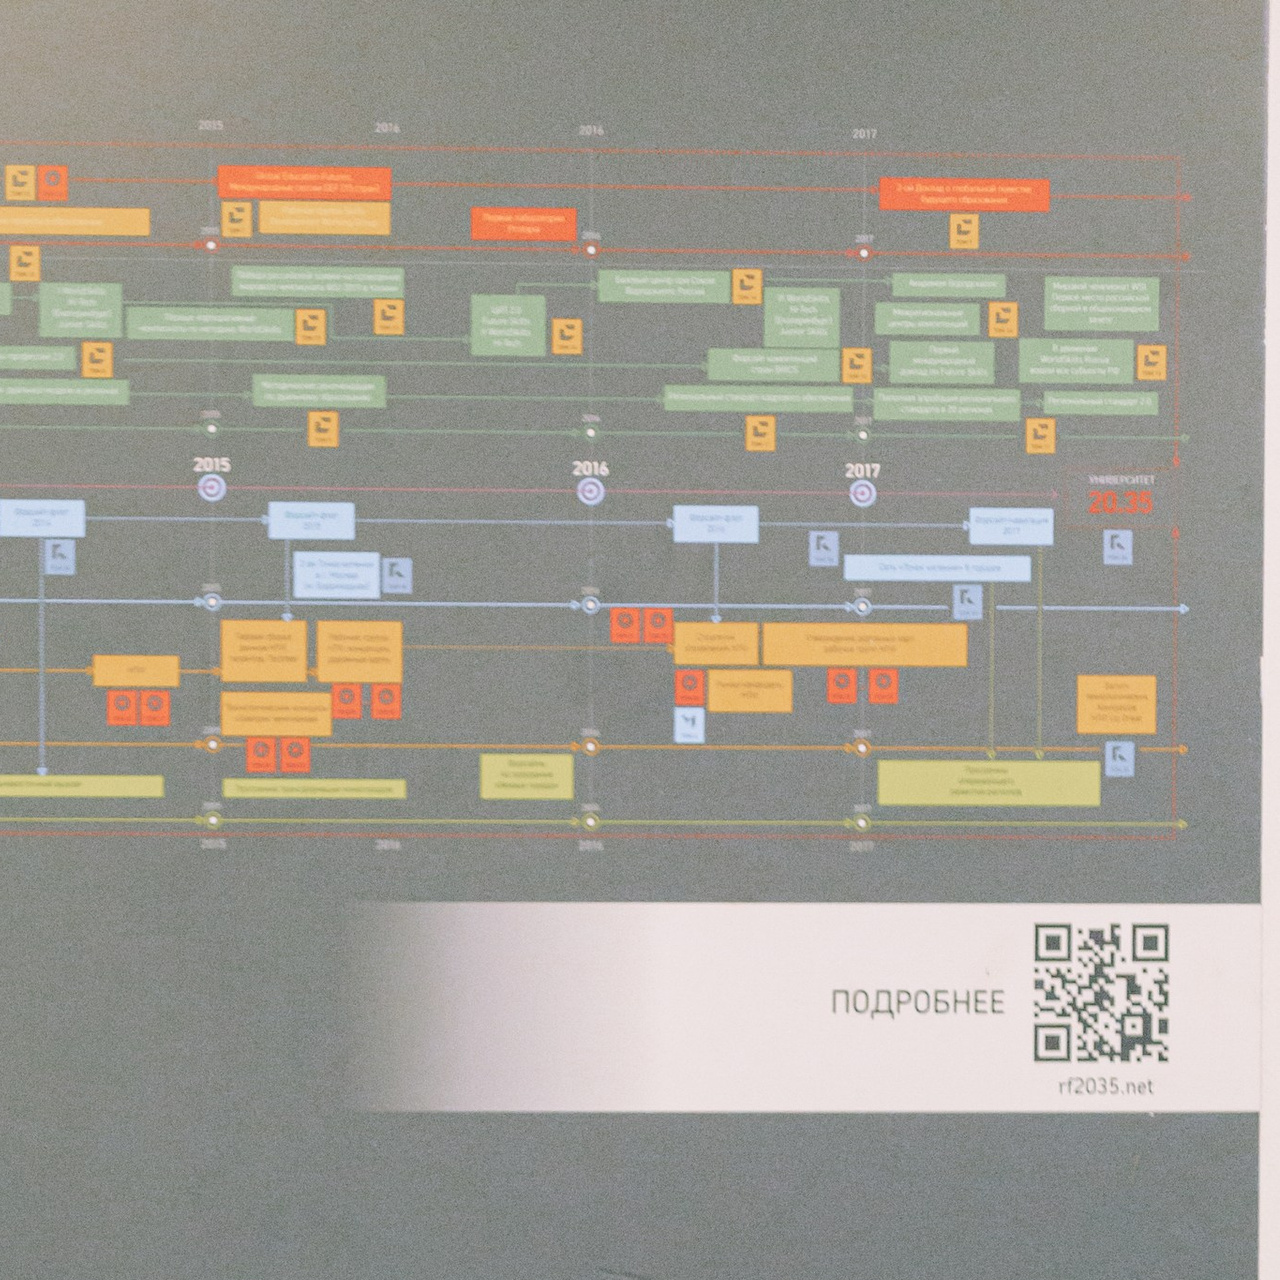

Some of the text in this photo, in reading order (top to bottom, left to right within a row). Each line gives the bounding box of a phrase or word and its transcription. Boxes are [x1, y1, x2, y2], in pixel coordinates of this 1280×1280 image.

[852, 129, 878, 140] 2017
[193, 457, 231, 472] 2015
[572, 460, 609, 476] 2016
[845, 463, 881, 478] 2017
[1088, 491, 1154, 514] 20.35
[832, 988, 1006, 1019] ПОДРОБНЕЕ
[1059, 1076, 1154, 1096] rf2035.net
